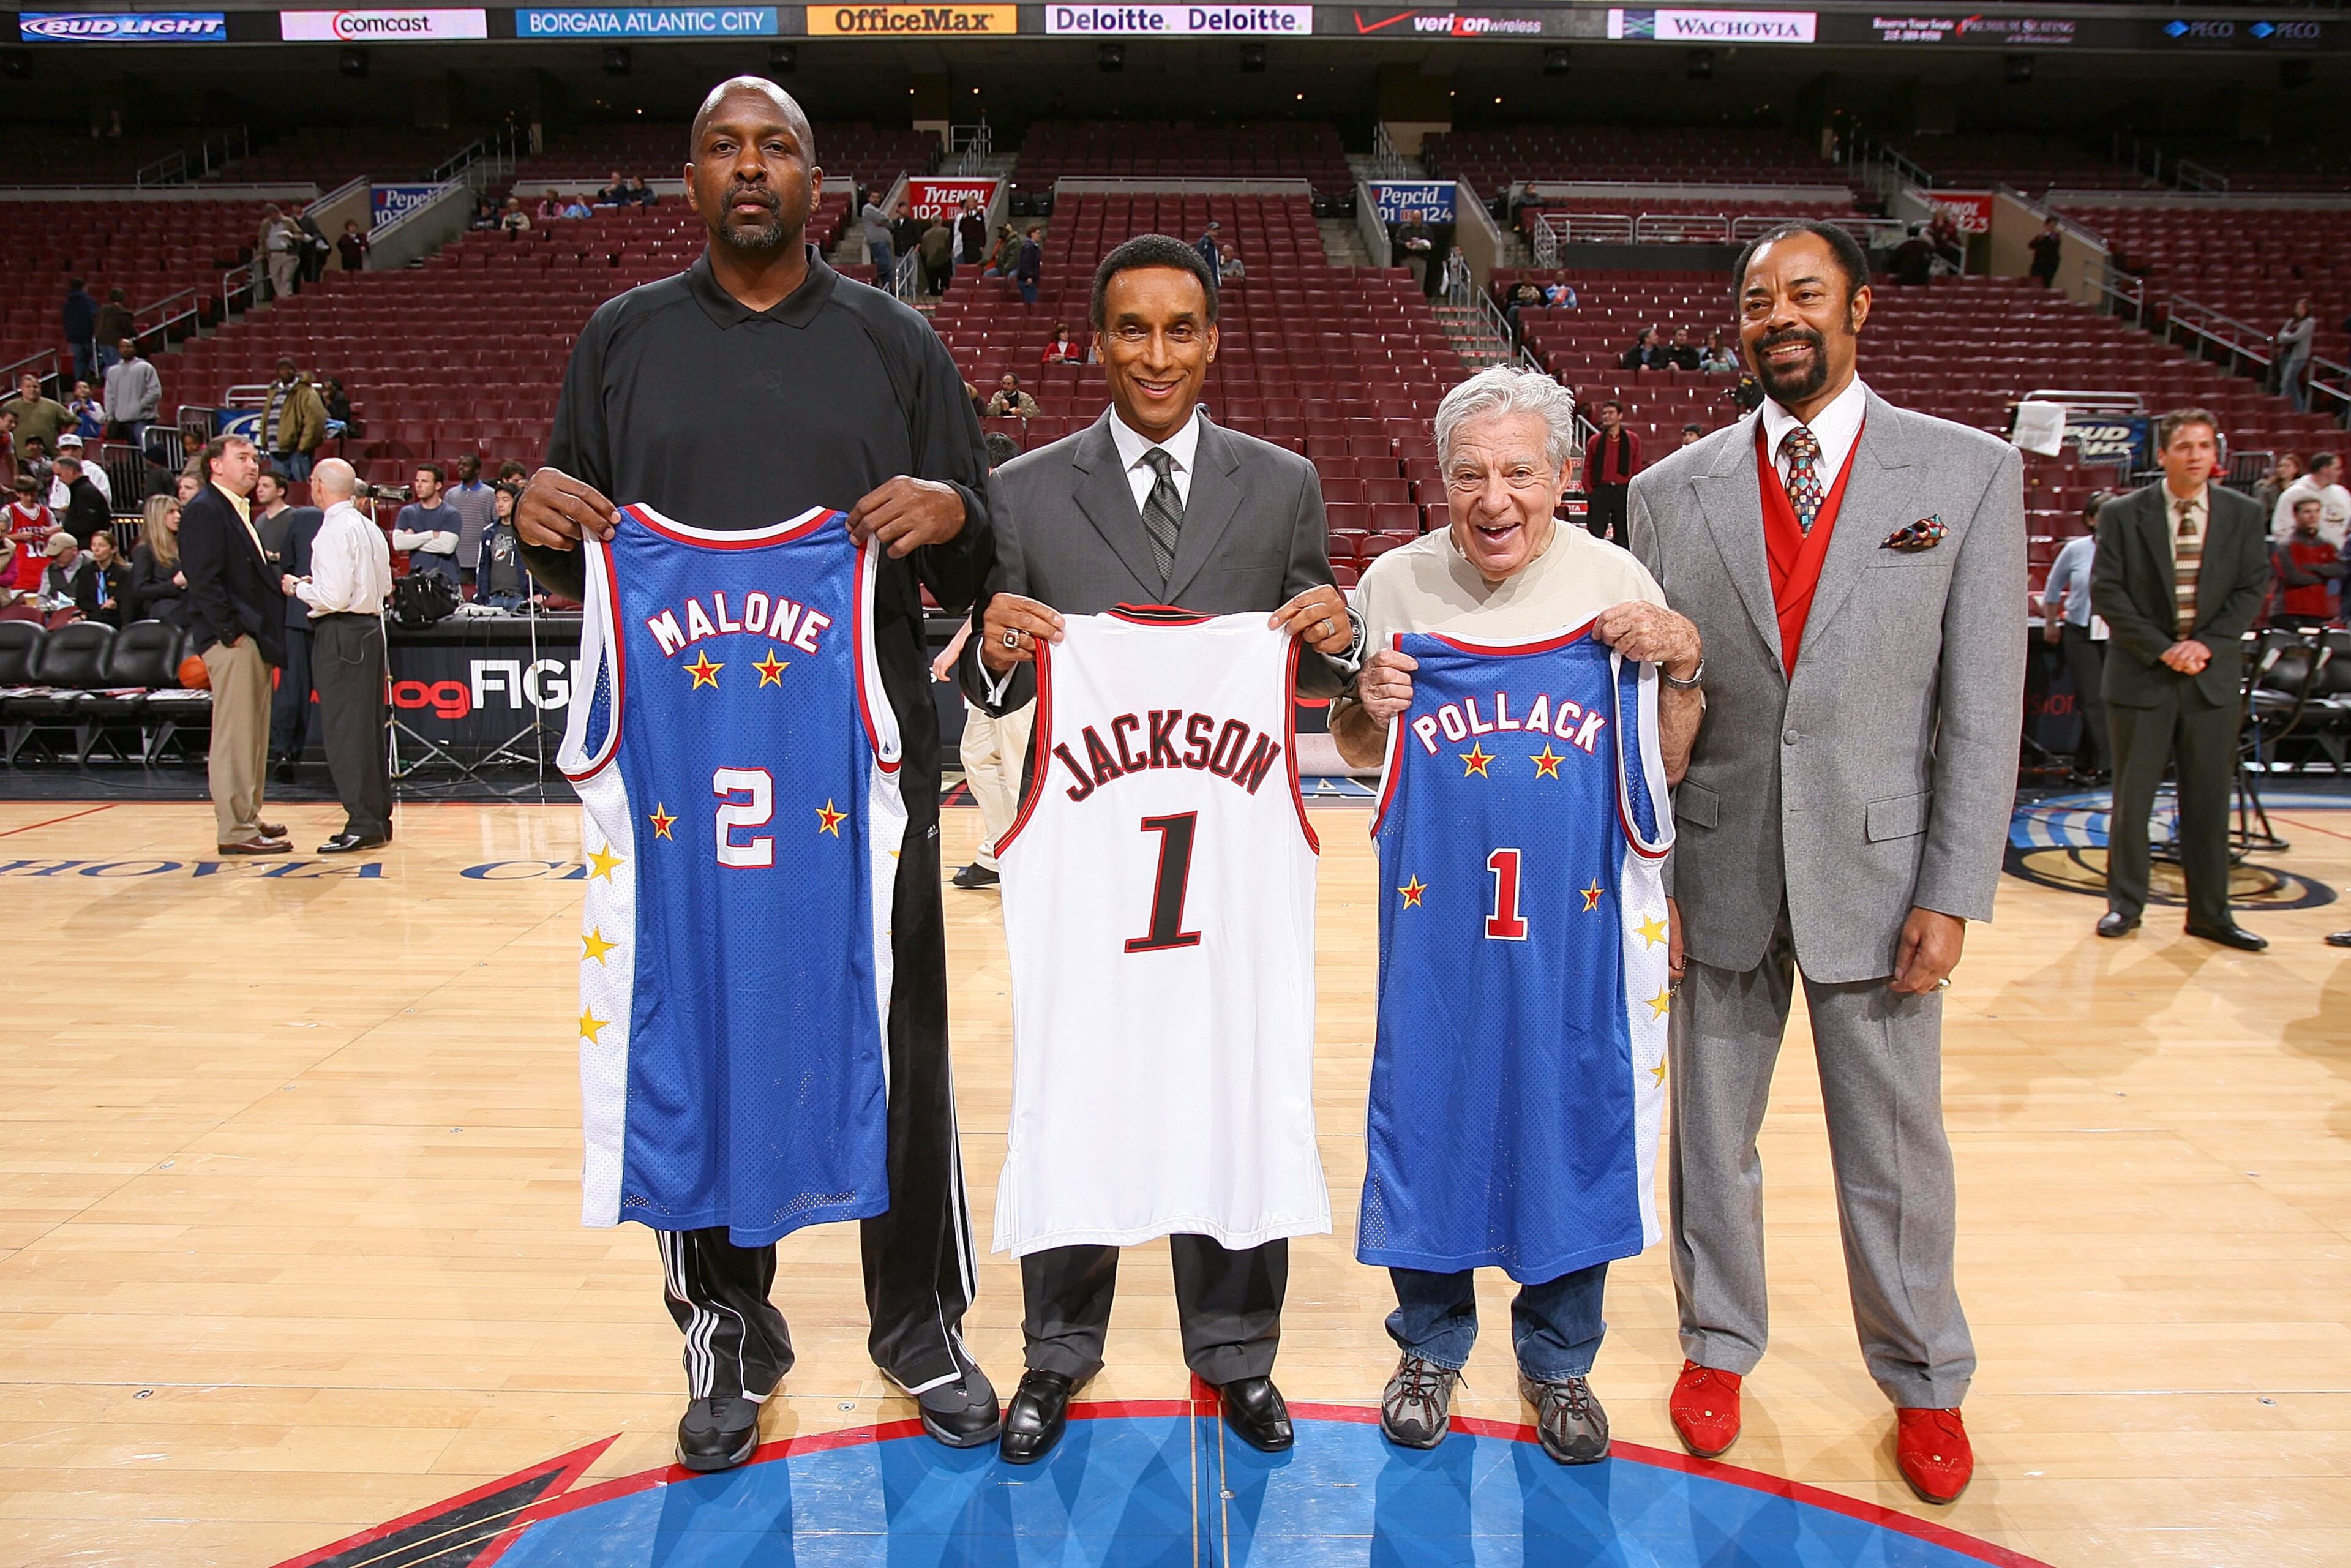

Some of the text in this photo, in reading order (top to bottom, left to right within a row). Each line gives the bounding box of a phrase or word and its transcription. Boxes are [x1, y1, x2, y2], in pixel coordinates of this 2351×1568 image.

[43, 20, 224, 34] BUD LIGHT
[340, 15, 432, 32] comcast
[530, 11, 765, 33] BORGATA ATLANTIC CITY
[835, 7, 989, 31] OfficeMax
[1673, 17, 1799, 37] WACHOVIA
[2189, 22, 2234, 38] PECO
[2275, 23, 2320, 39] PECO
[1378, 186, 1439, 208] Pepcid
[912, 204, 942, 220] 102
[1422, 207, 1453, 222] 124
[646, 590, 833, 658] MALONE
[1411, 691, 1607, 756] POLLACK
[1051, 709, 1282, 803] JACKSON
[712, 767, 775, 869] 2
[1123, 810, 1201, 954] 1
[1484, 847, 1529, 941] 1
